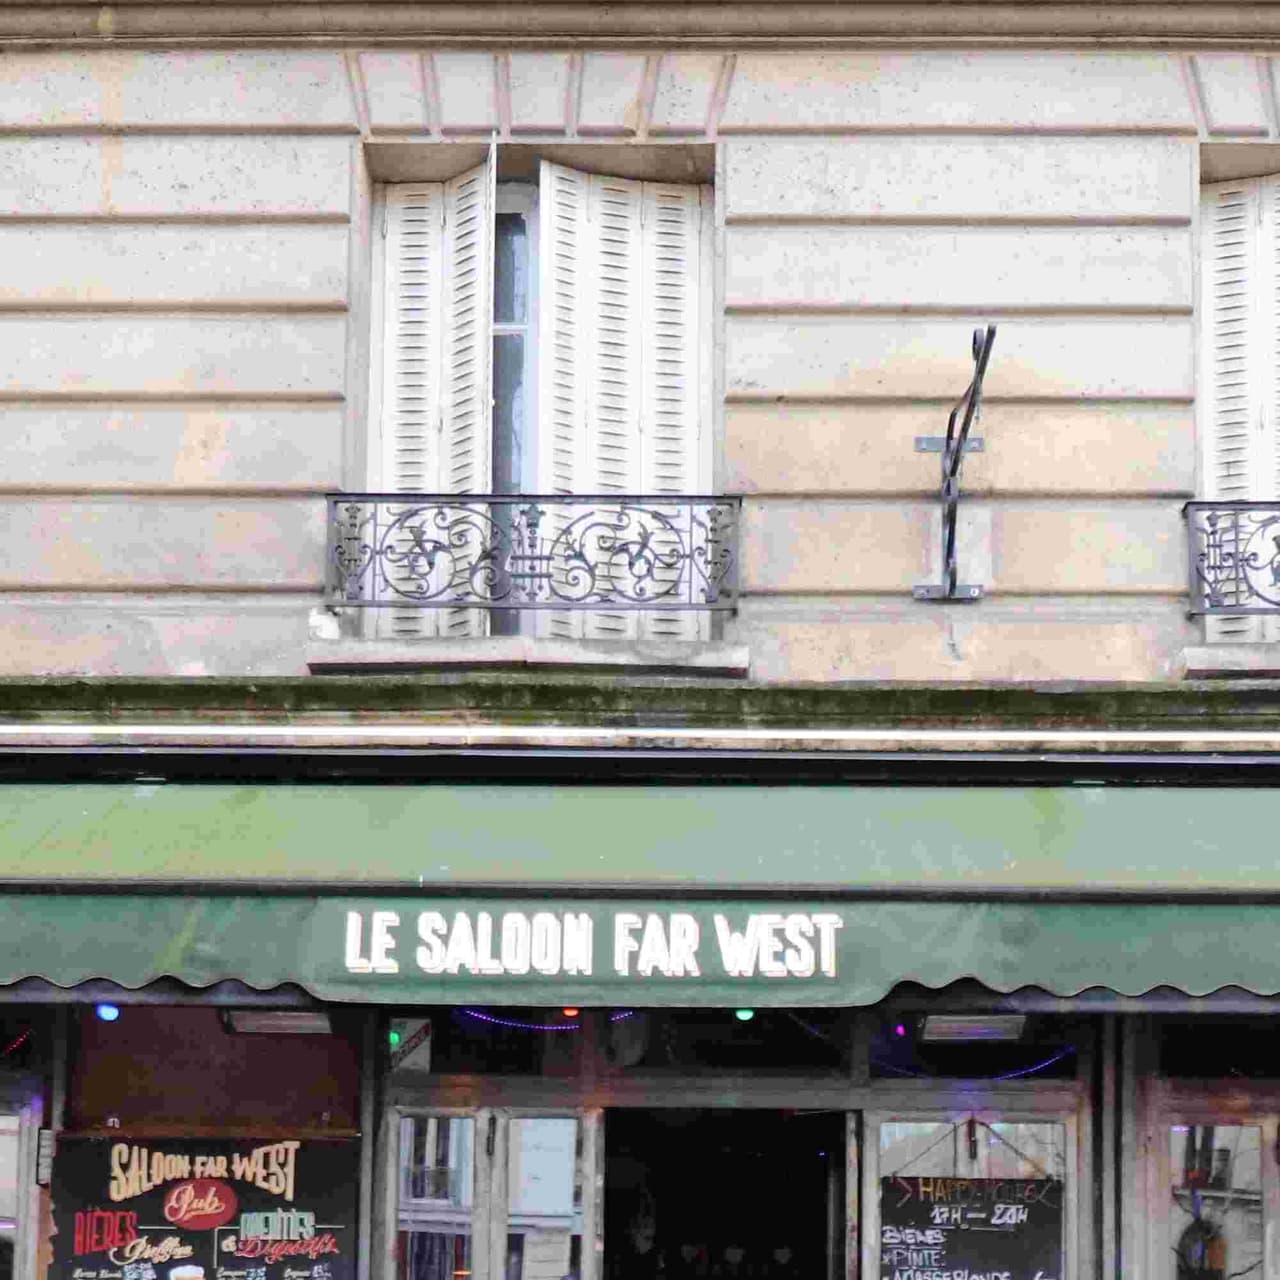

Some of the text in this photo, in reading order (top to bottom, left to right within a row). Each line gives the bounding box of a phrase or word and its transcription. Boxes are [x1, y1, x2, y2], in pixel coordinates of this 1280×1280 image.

[345, 911, 843, 978] LE SALOON FAR WEST
[109, 1140, 301, 1202] SALOON FAR WEST
[164, 1183, 225, 1222] Pub
